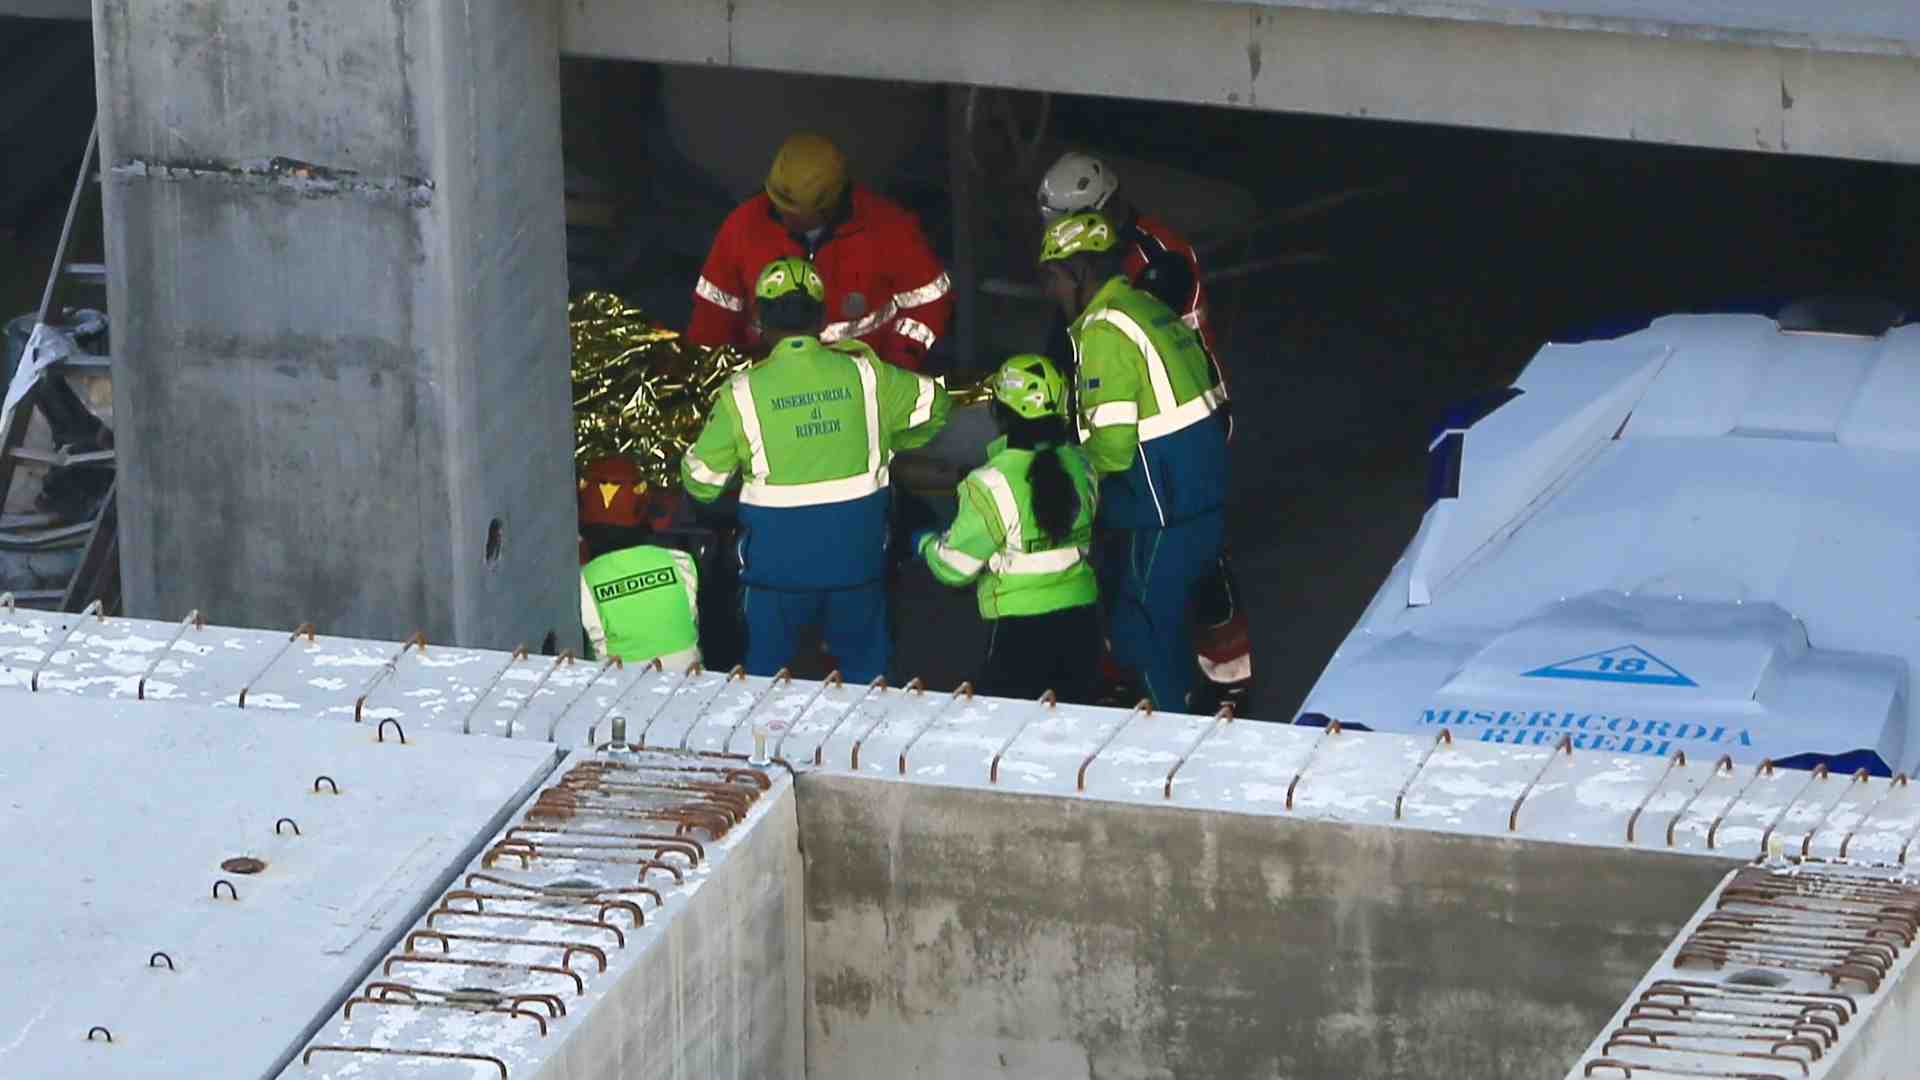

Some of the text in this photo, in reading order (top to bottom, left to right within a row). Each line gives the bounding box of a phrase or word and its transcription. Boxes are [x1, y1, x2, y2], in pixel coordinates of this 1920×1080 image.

[770, 386, 853, 410] MISERICORDIA
[811, 406, 822, 420] di
[795, 418, 841, 439] RIFREDI
[599, 571, 671, 599] MEDICO
[1598, 656, 1648, 673] 18
[1417, 708, 1752, 747] MISERICORDIA
[1480, 728, 1673, 756] RIFREDI
